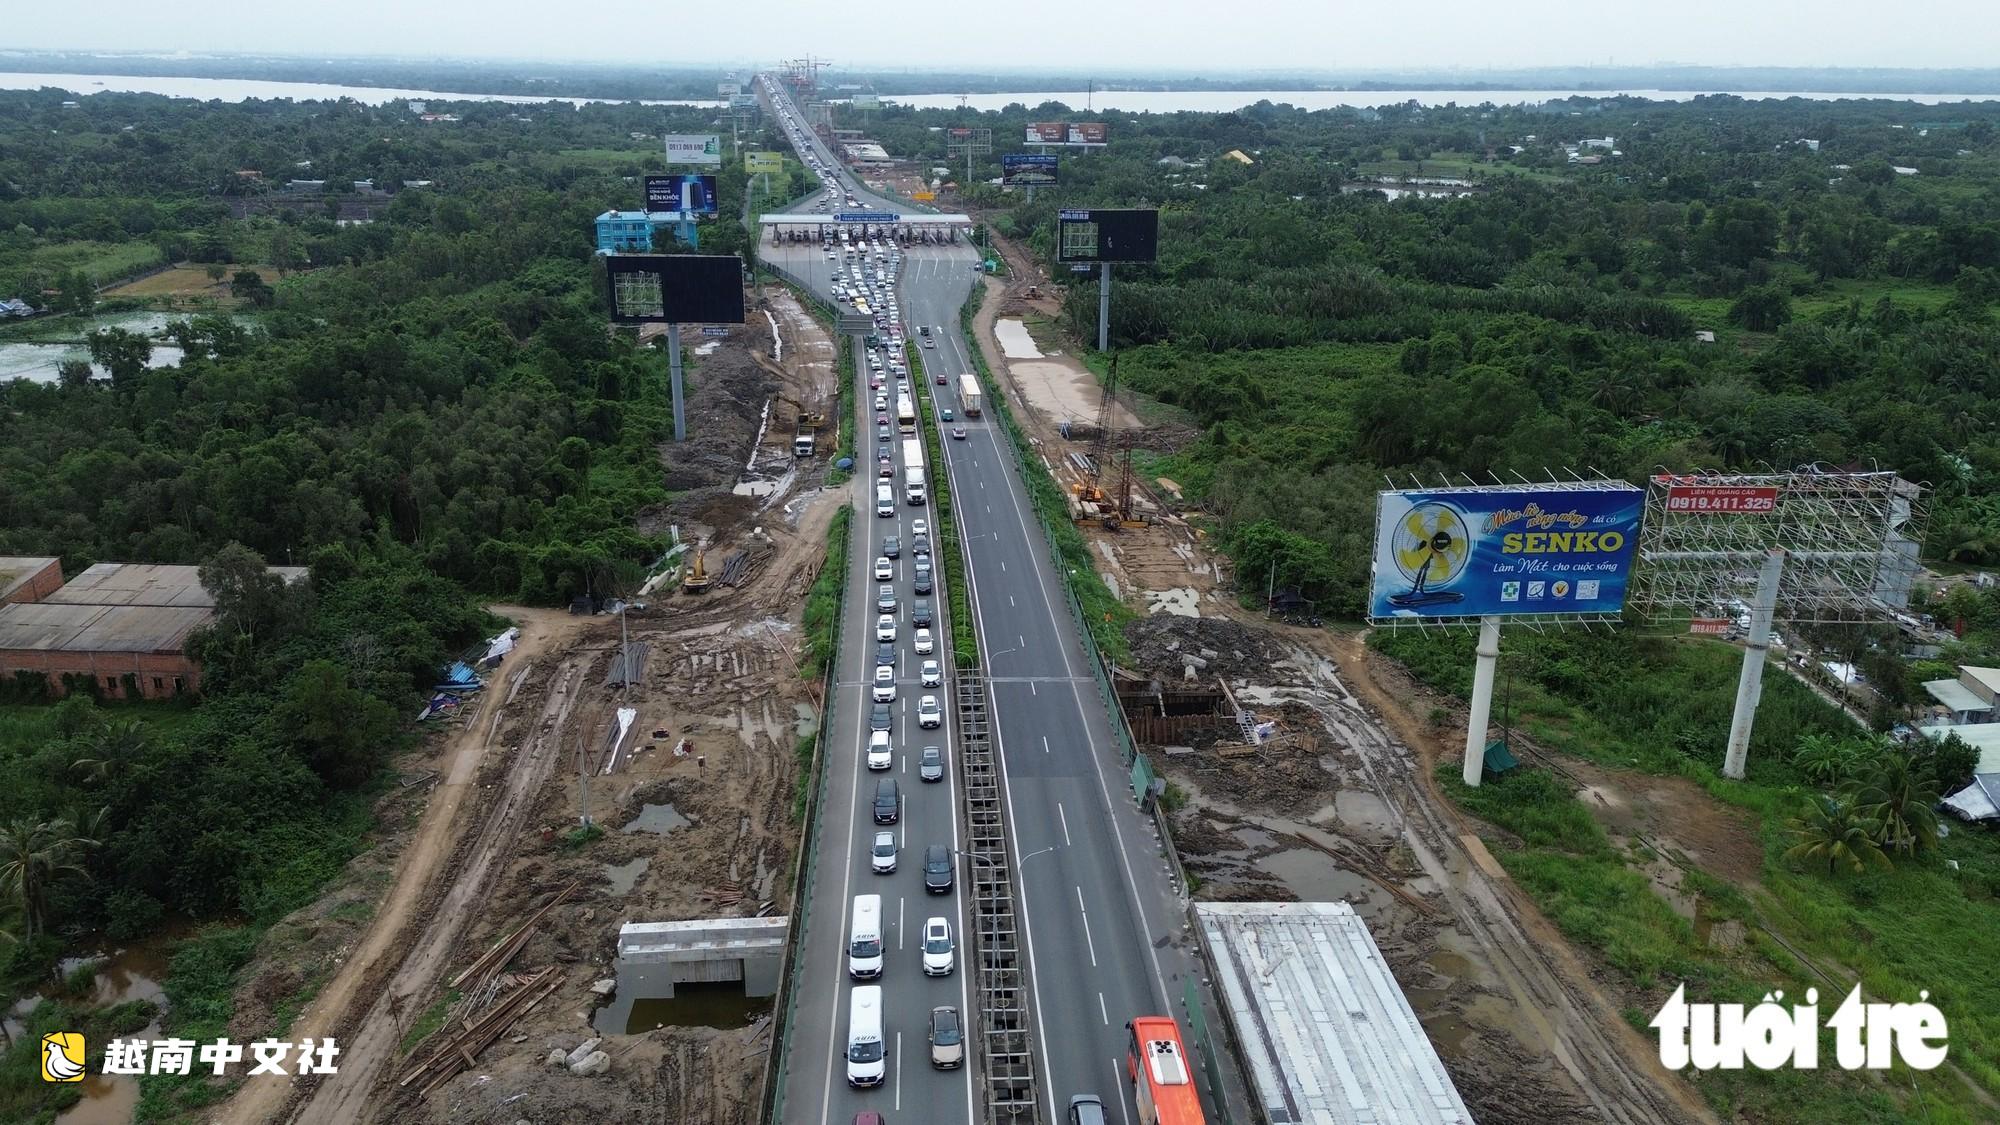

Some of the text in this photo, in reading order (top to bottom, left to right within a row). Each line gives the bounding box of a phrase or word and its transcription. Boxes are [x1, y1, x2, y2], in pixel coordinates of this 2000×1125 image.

[1670, 497, 1772, 509] 0919.411.325
[1502, 532, 1624, 553] SENKO
[1493, 558, 1618, 574] Làm Mát cho cuộc sống
